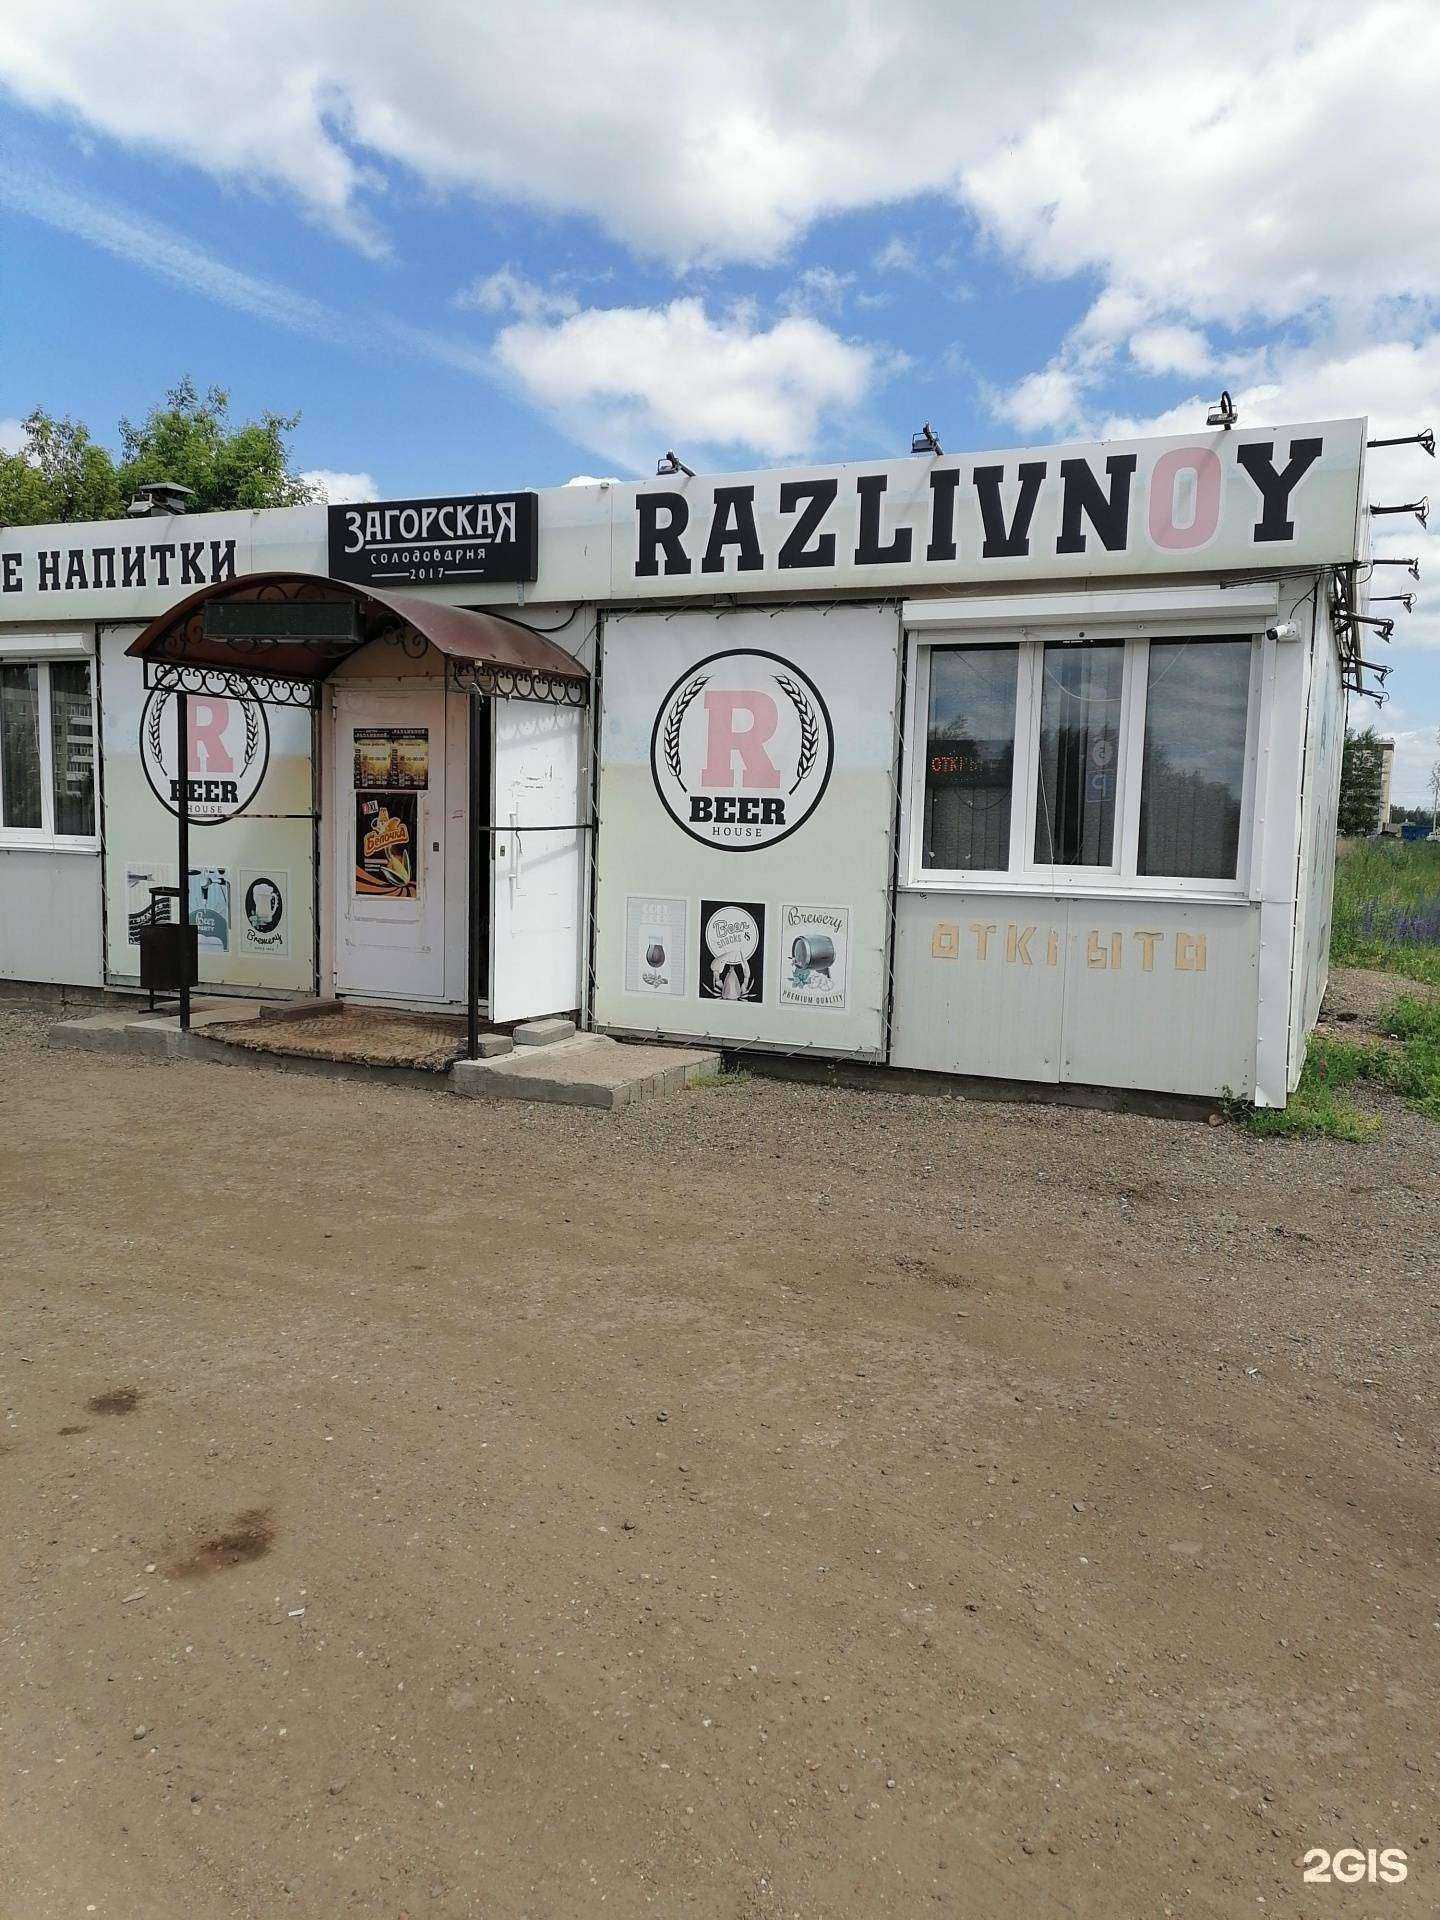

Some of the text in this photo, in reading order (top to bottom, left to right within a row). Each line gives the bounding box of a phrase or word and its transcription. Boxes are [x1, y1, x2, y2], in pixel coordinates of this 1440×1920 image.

[635, 438, 1323, 576] RAZLIVNOY
[345, 502, 516, 553] ЗАГОРСКАЯ
[38, 540, 236, 590] НАПИТКИ
[409, 567, 444, 580] 2017
[701, 690, 781, 788] R
[689, 796, 786, 825] BEER
[712, 827, 762, 837] HOUSE
[788, 906, 842, 933] Brewery
